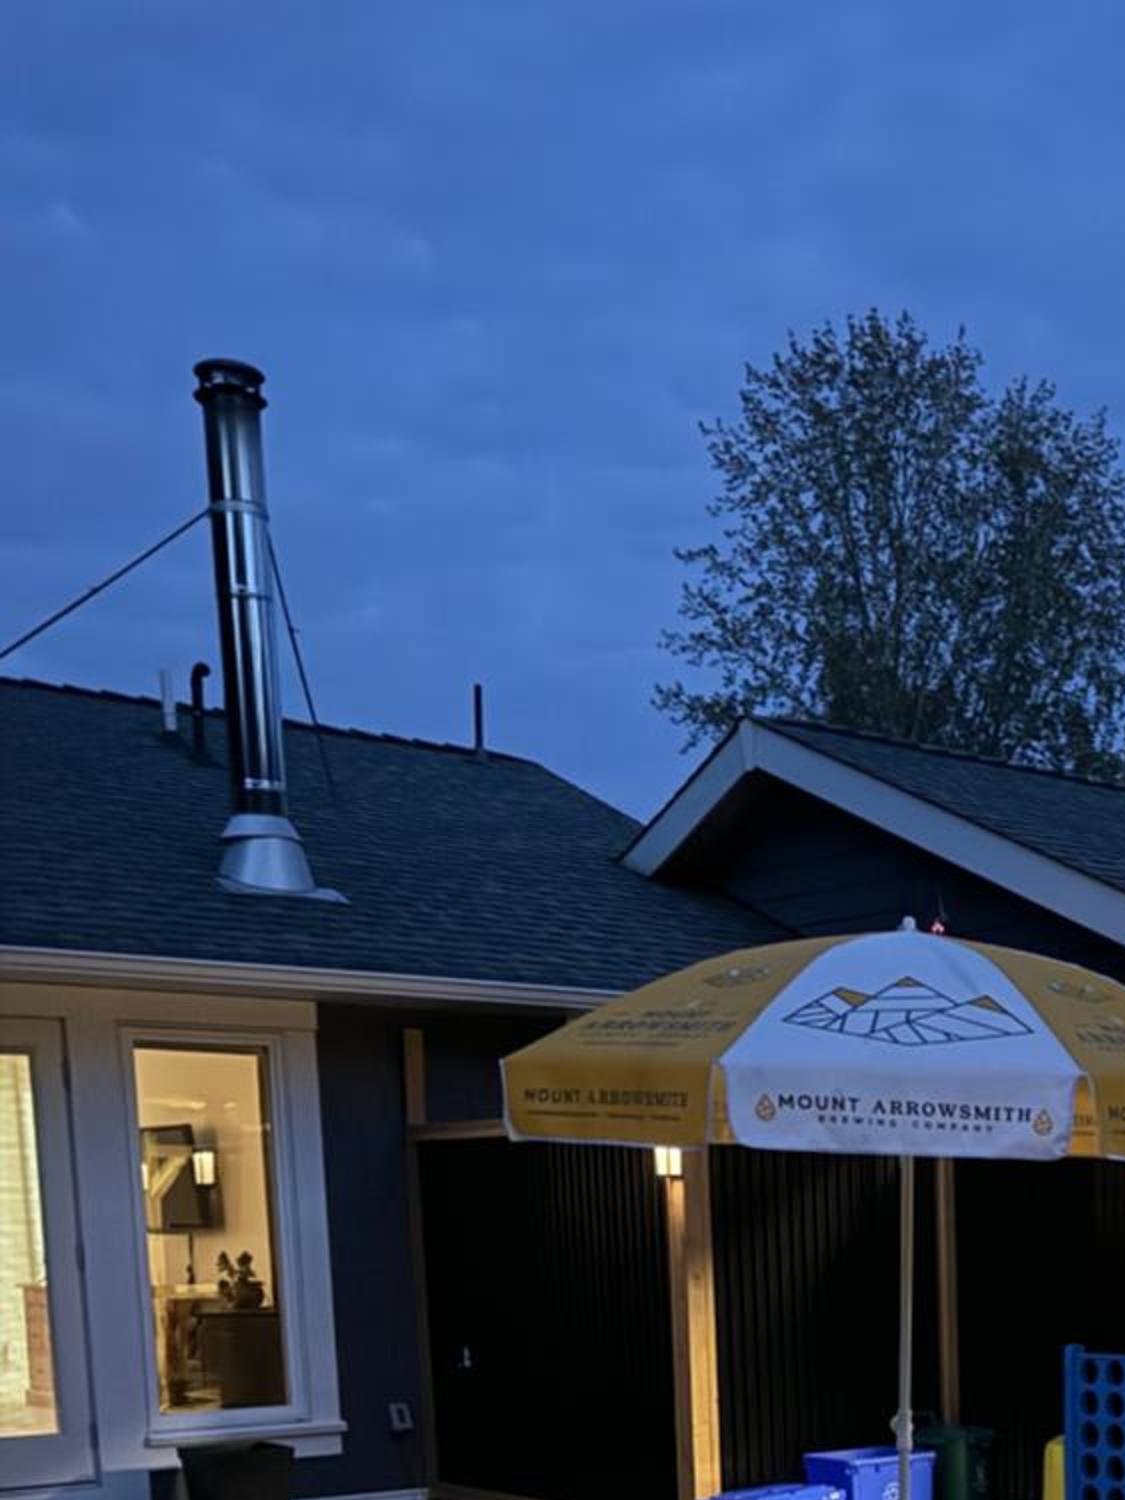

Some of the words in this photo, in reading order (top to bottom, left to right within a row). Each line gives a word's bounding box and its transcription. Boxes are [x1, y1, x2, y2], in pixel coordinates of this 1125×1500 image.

[524, 1088, 581, 1104] MOUNT
[777, 1094, 860, 1112] MOUNT
[872, 1099, 1031, 1122] ARROWSMITH
